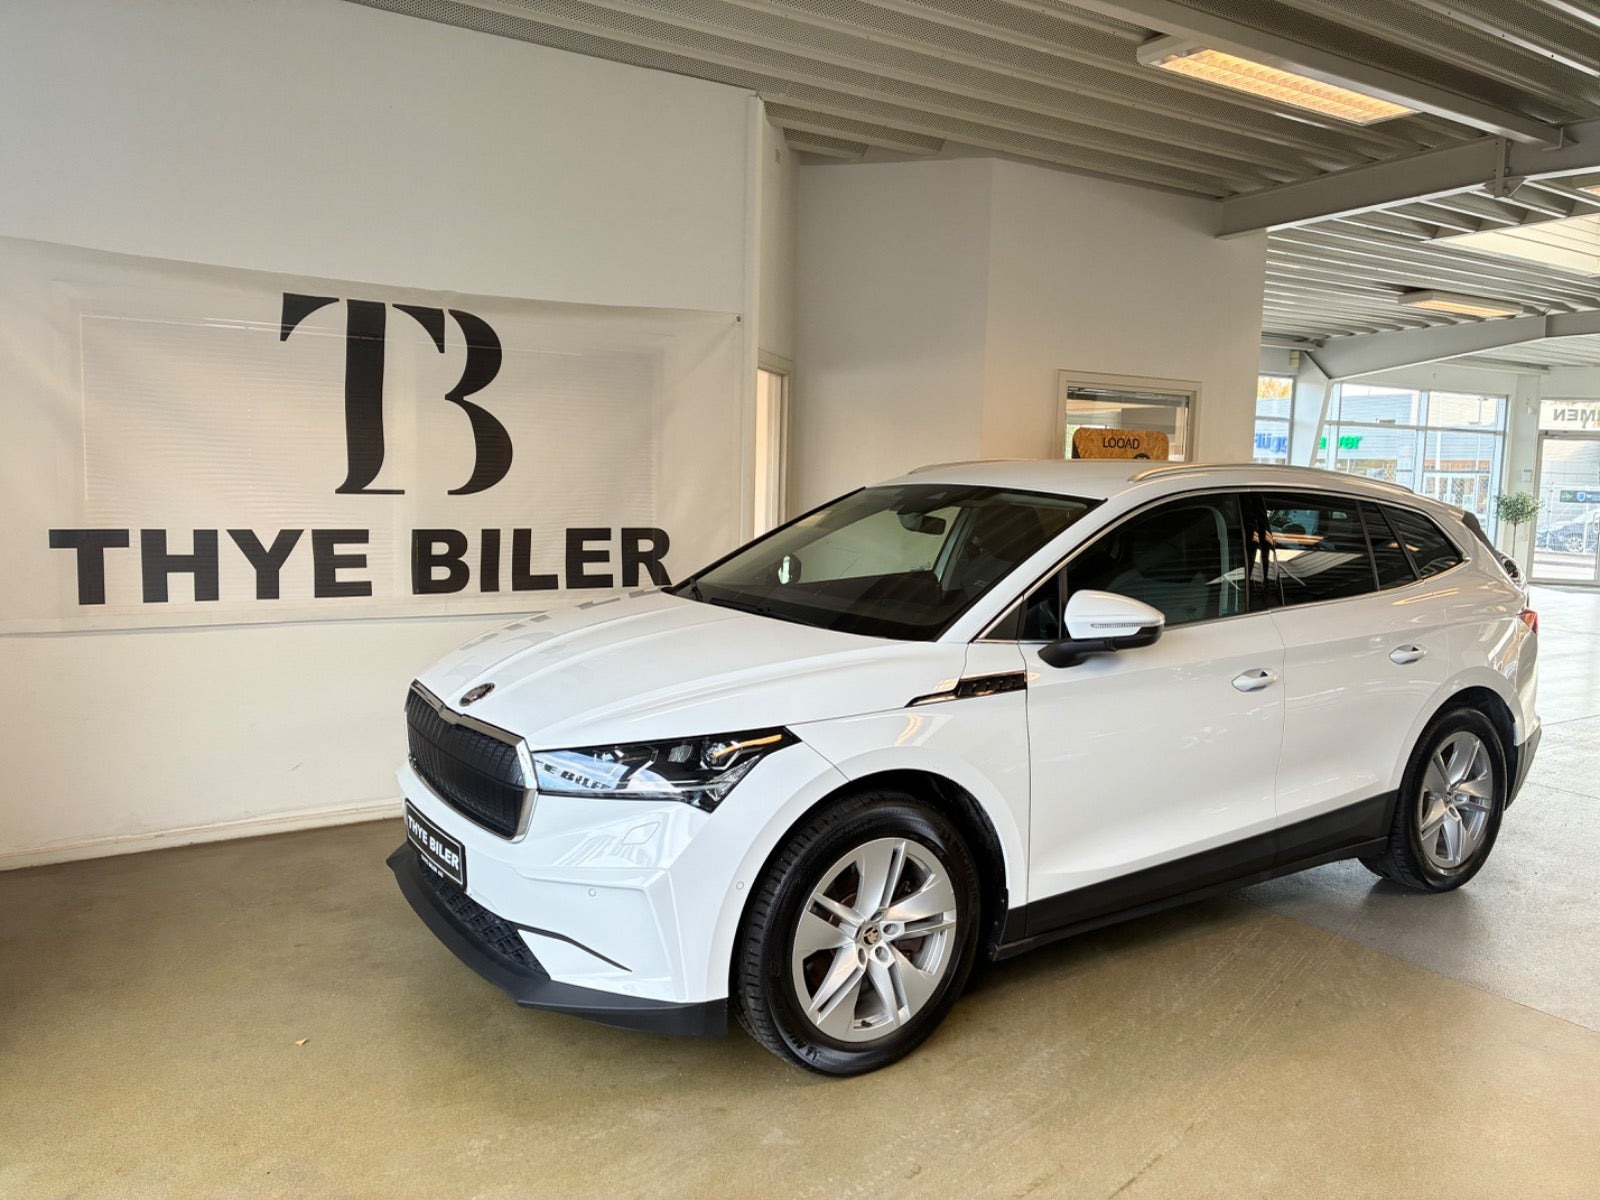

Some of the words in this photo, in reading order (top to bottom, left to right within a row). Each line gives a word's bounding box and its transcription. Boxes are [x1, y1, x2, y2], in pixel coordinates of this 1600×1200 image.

[1103, 437, 1140, 450] LOOAD
[49, 528, 373, 606] THYE
[411, 527, 673, 595] BILER
[408, 815, 428, 845] THYE
[429, 836, 459, 870] BILER
